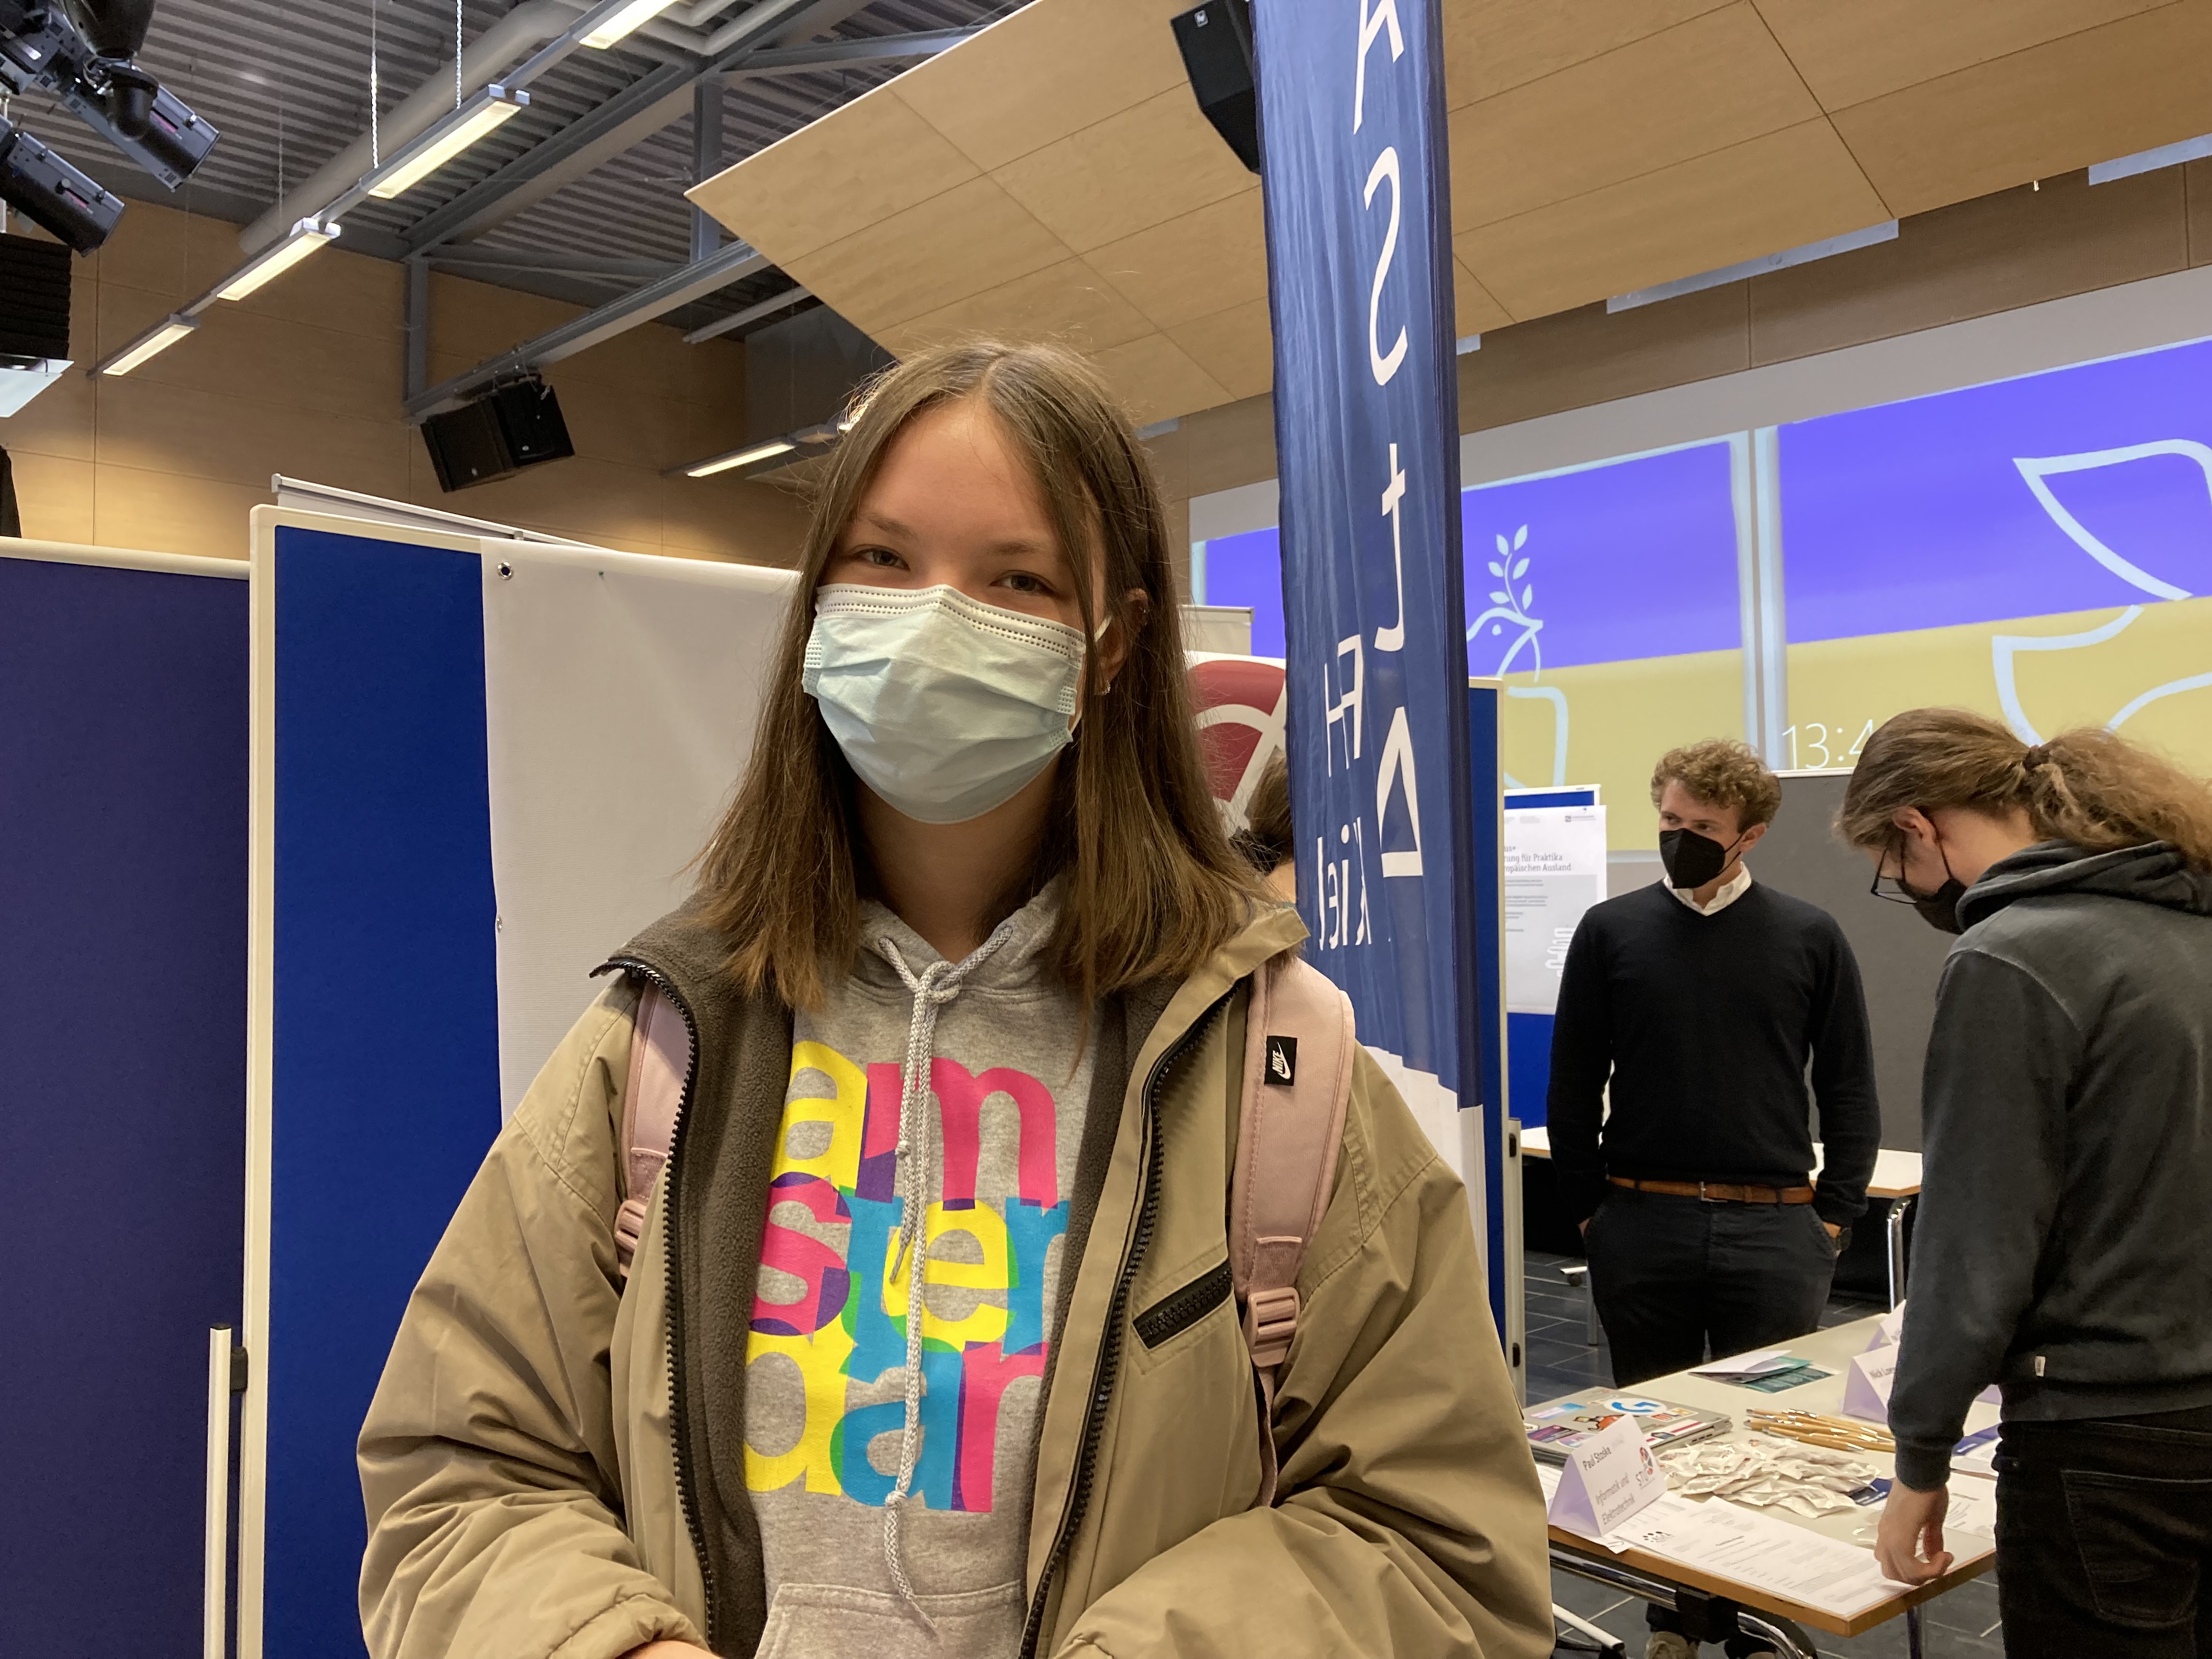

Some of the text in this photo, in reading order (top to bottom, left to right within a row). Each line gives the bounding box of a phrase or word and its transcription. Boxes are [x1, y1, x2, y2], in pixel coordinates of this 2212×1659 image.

[1543, 863, 1571, 872] Ausland
[1272, 1050, 1284, 1074] NIKE
[1582, 1454, 1596, 1471] Paul
